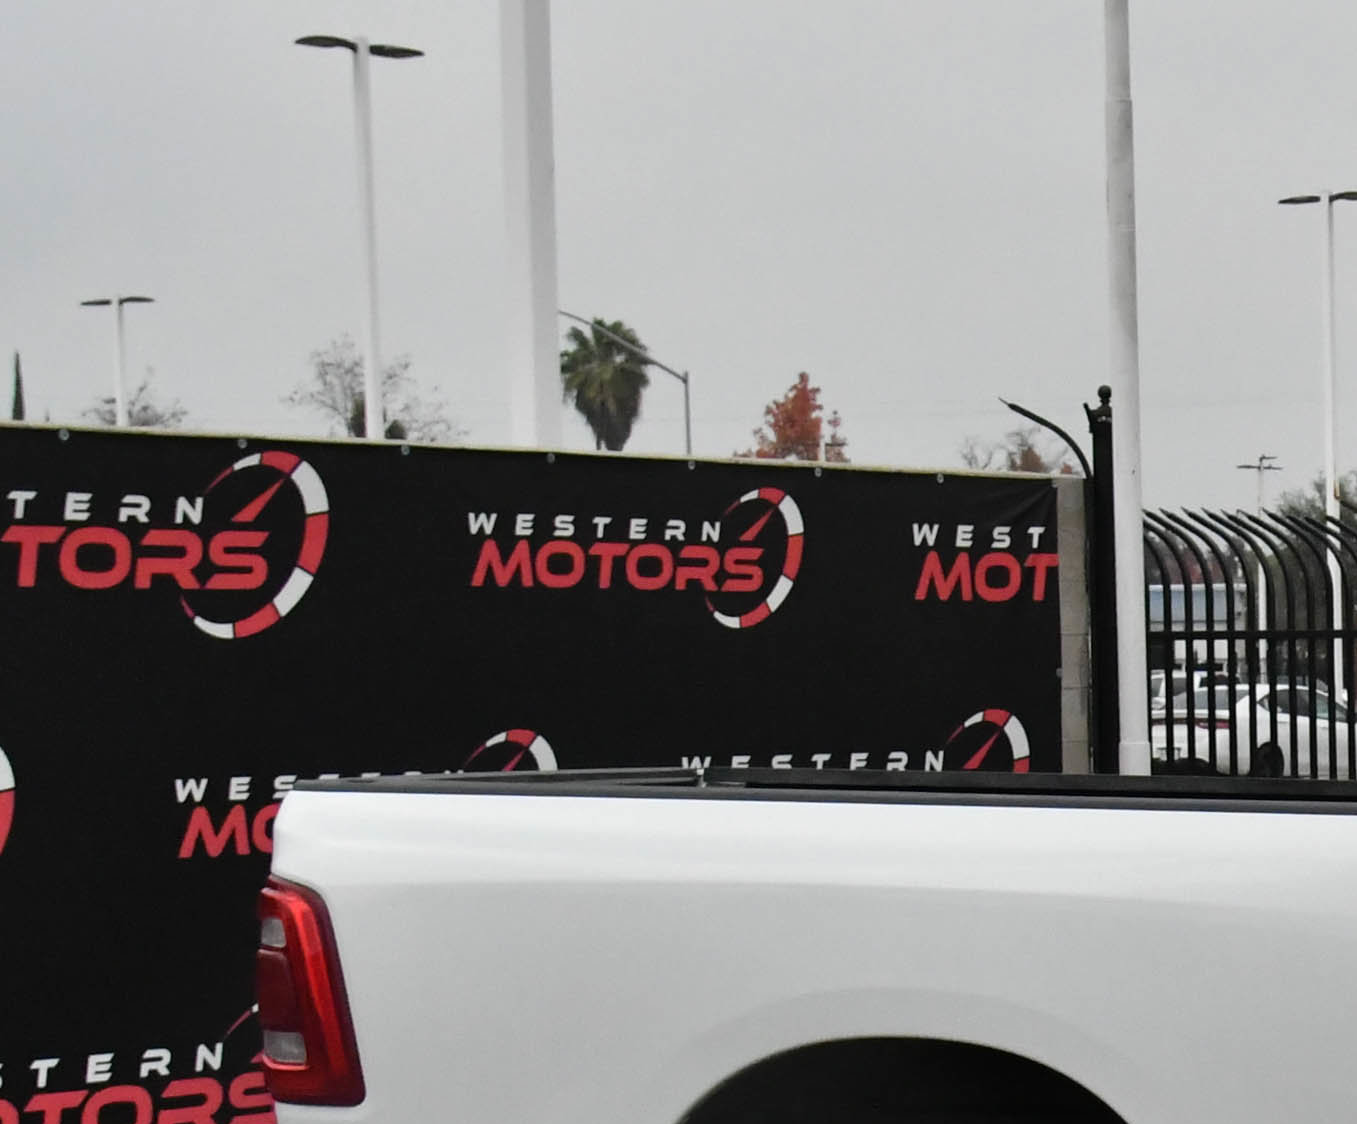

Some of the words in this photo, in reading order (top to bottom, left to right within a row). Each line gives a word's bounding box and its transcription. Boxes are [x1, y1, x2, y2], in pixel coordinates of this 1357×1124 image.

[468, 512, 721, 542] WESTERN
[912, 523, 1046, 549] WEST
[471, 539, 765, 592] MOTORS
[0, 1042, 223, 1089] TERN
